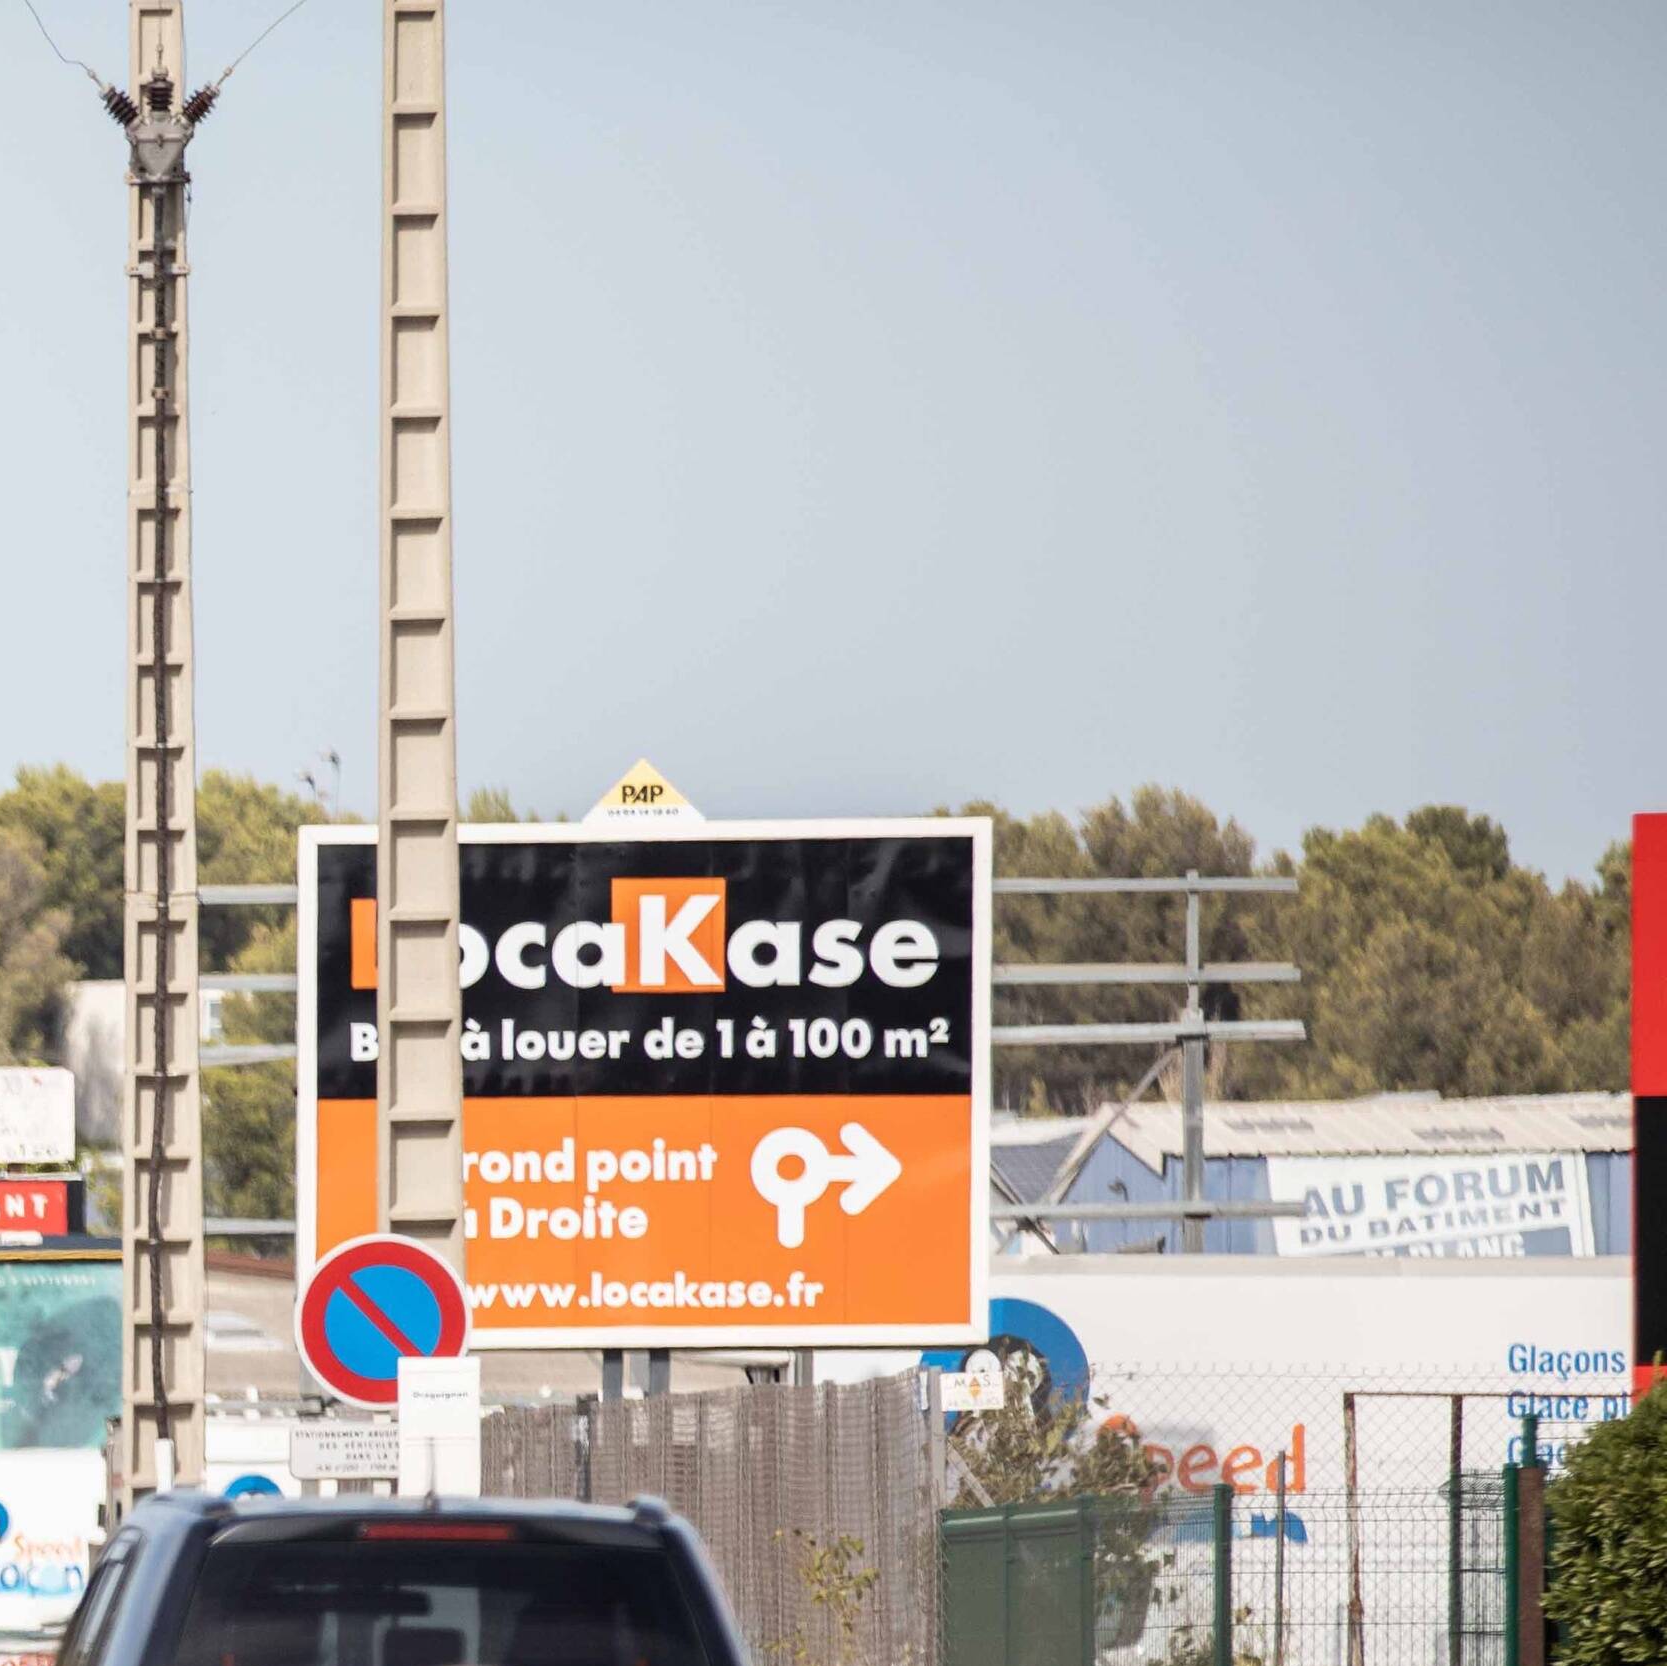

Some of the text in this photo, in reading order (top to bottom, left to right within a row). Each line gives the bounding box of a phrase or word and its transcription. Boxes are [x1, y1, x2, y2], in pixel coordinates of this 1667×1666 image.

[621, 785, 663, 803] PAP
[461, 1015, 490, 1059] à
[501, 1019, 630, 1060] louer
[644, 1019, 703, 1059] de
[716, 1020, 732, 1058] 1
[745, 1015, 776, 1059] à
[789, 1017, 871, 1059] 100
[463, 1137, 717, 1193] rond point
[1303, 1160, 1564, 1221] AU FORUM
[489, 1195, 648, 1240] Droite
[1299, 1224, 1352, 1248] DU
[468, 1271, 825, 1309] www.locakase.fr
[1507, 1342, 1627, 1380] Glaçons
[1507, 1390, 1589, 1420] Glace
[1096, 1413, 1306, 1505] peed
